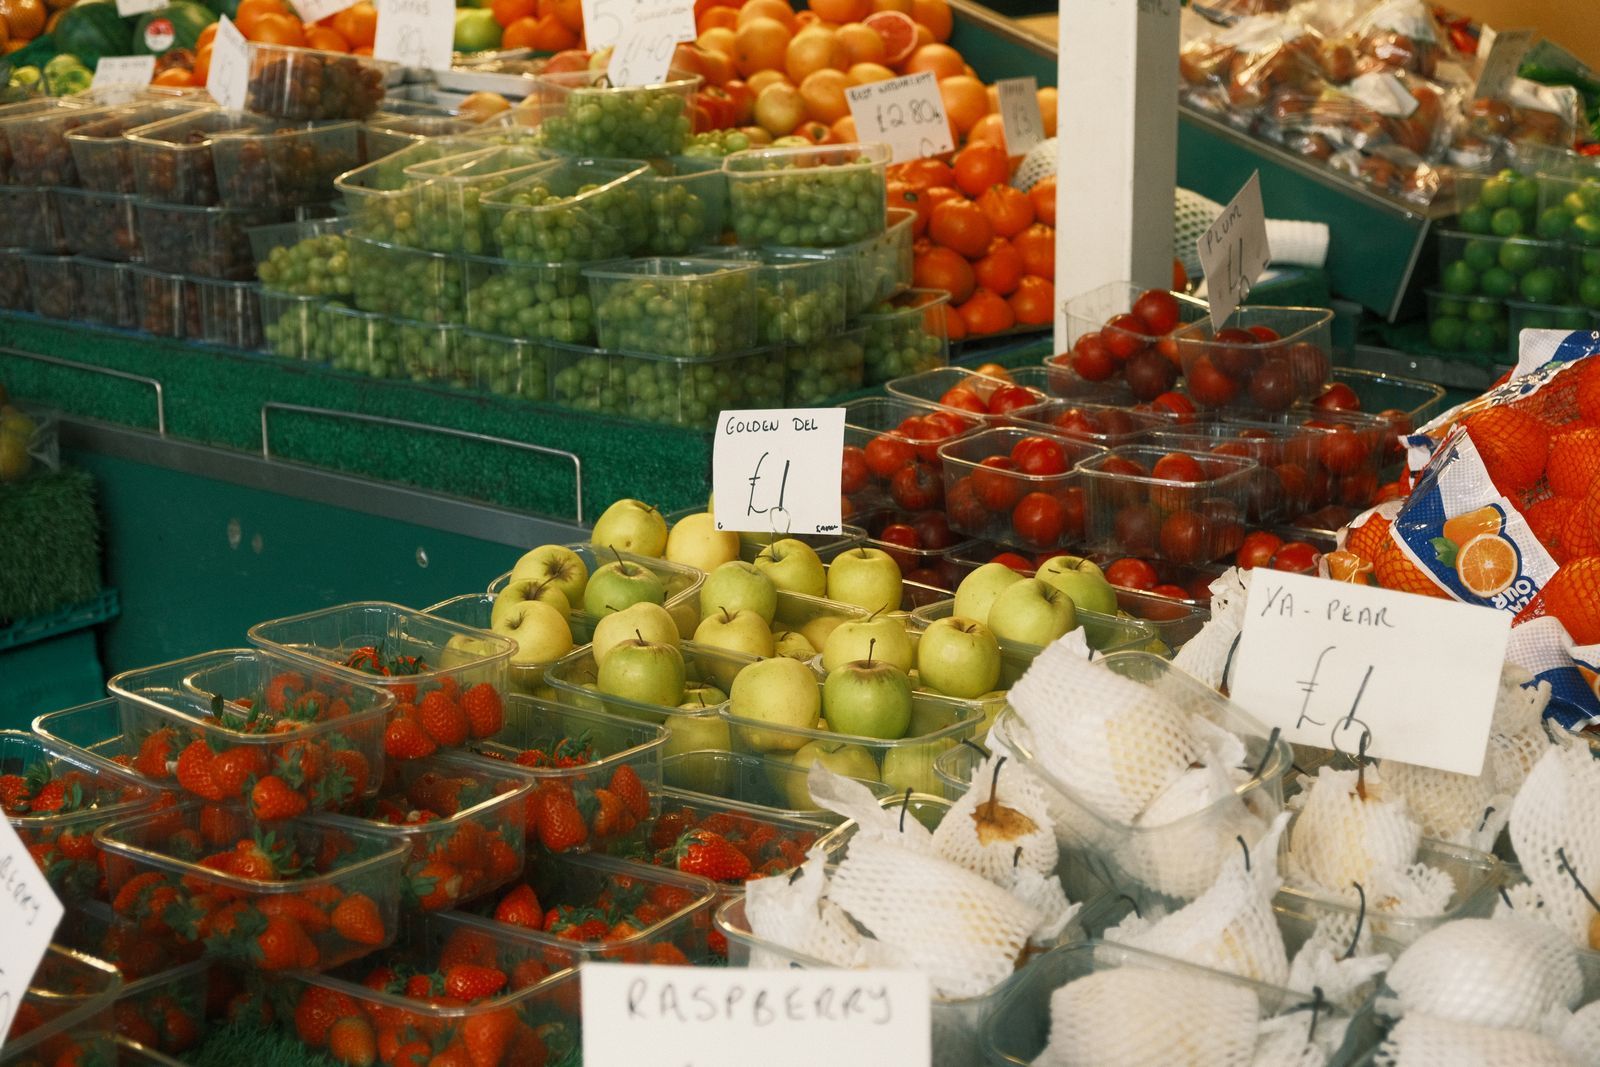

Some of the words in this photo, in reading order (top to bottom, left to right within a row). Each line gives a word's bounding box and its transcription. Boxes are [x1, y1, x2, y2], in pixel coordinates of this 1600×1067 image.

[1207, 205, 1242, 254] PLUM
[726, 416, 779, 435] GOLDEN
[793, 417, 818, 431] DEL
[748, 451, 790, 516] £1
[1327, 599, 1396, 628] PEAR
[1491, 579, 1532, 610] OUR
[627, 978, 893, 1026] RASPBERRY
